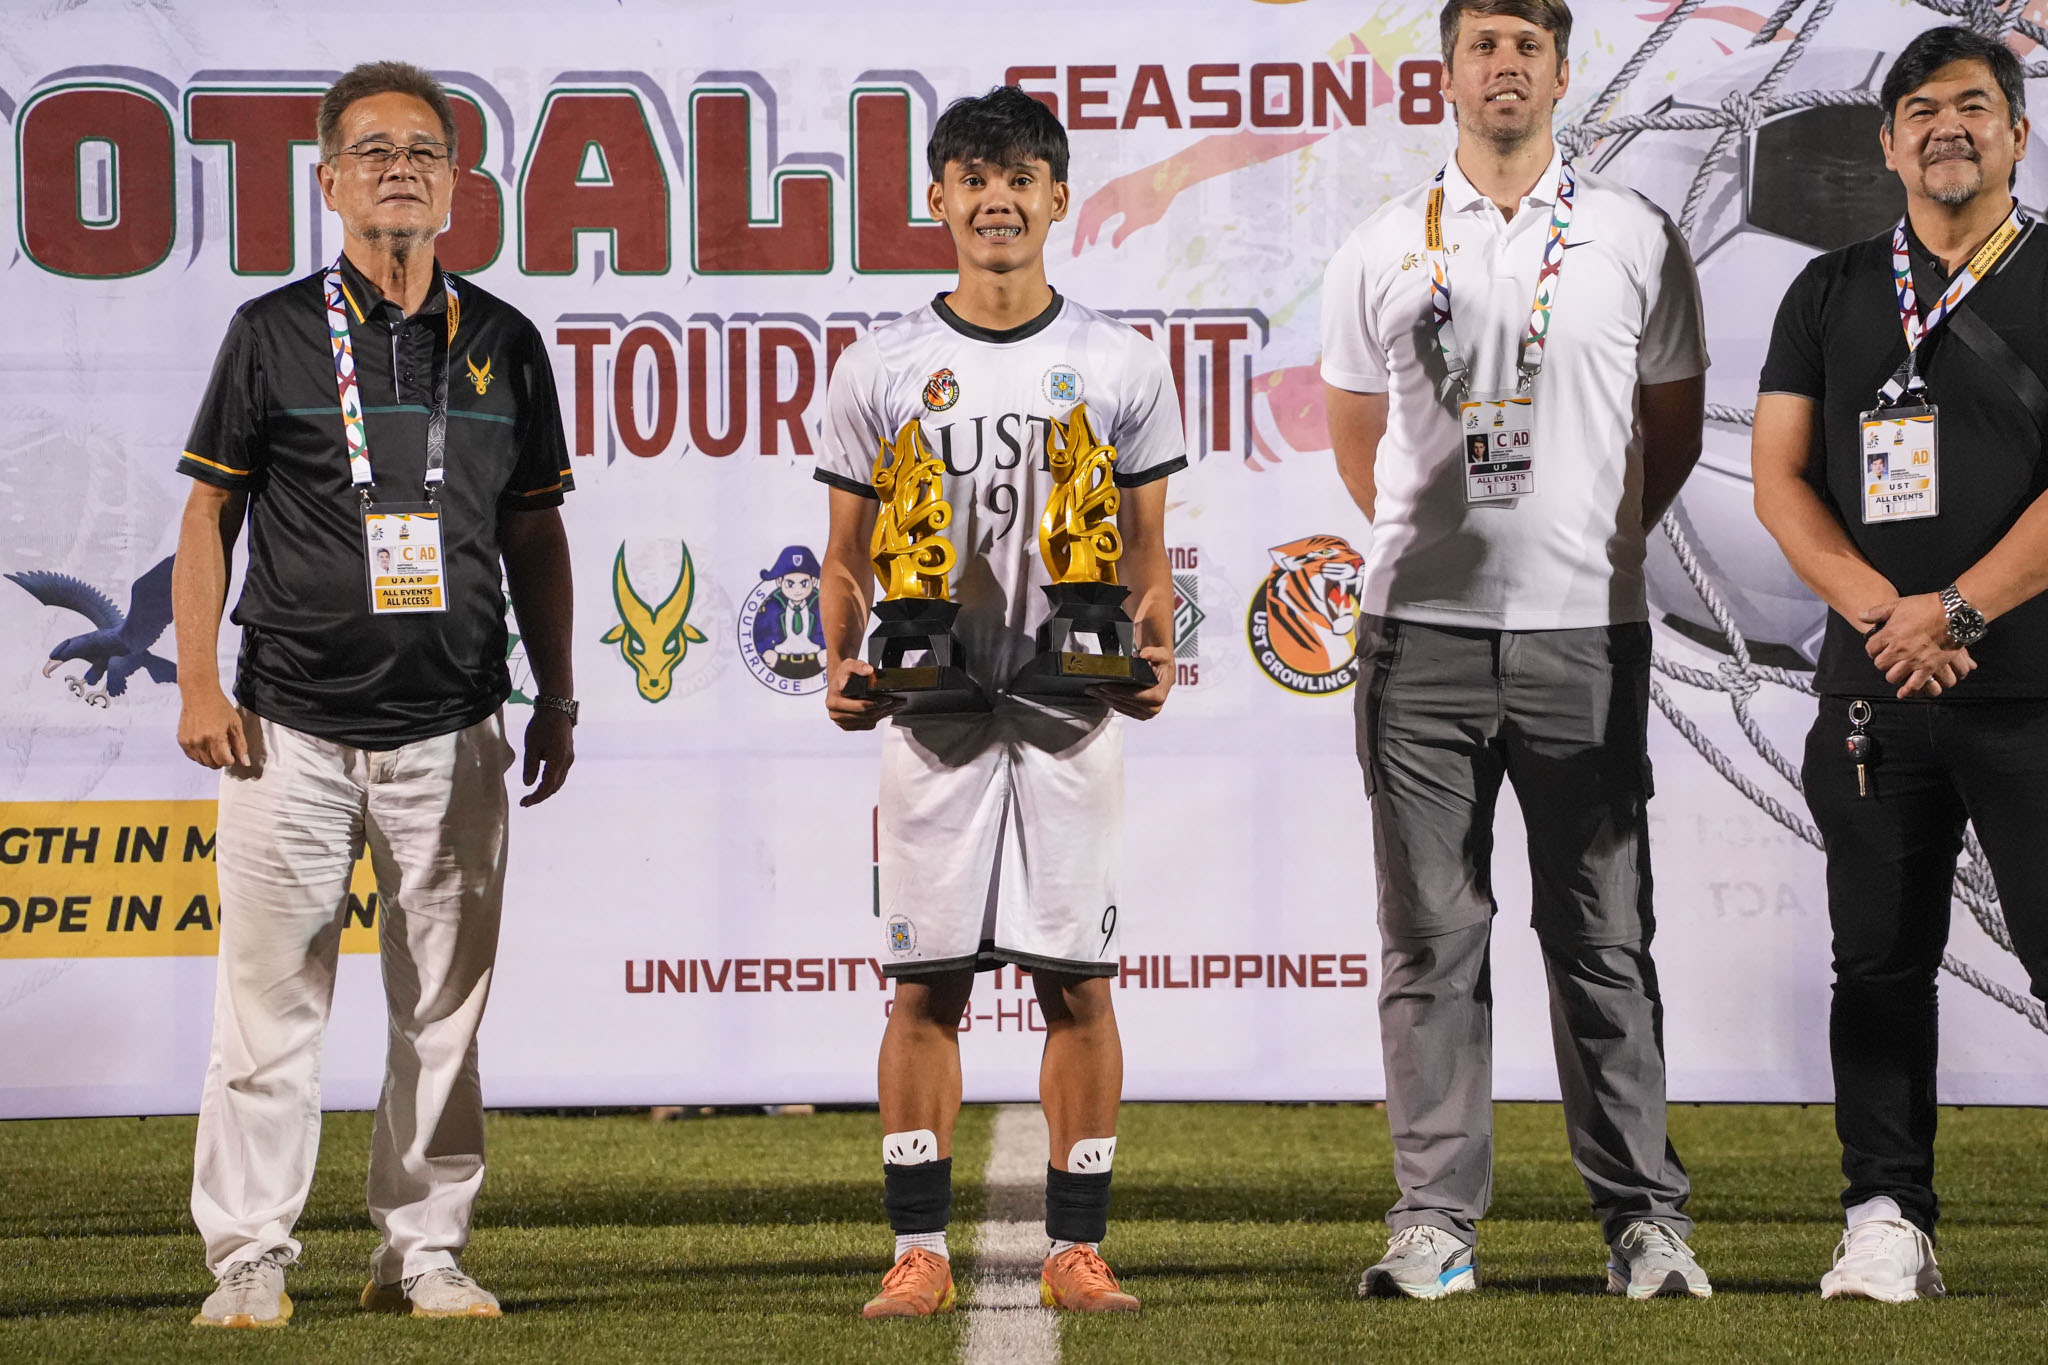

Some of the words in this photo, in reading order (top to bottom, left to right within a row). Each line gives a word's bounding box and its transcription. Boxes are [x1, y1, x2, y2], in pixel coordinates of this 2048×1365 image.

[1005, 61, 1366, 130] SEASON
[1991, 232, 2003, 246] HOPE
[1971, 250, 1987, 269] ACTION
[936, 412, 1069, 477] UST
[1497, 433, 1507, 447] C
[1513, 432, 1529, 446] AD
[1913, 450, 1929, 465] AD
[1487, 485, 1492, 494] 1
[1511, 483, 1517, 492] 3
[1494, 474, 1526, 483] EVENTS
[1892, 493, 1924, 502] EVENTS
[989, 483, 1019, 541] 9
[403, 547, 413, 561] C
[420, 546, 436, 561] AD
[387, 598, 400, 606] ALL
[402, 597, 430, 606] ACCESS
[742, 589, 800, 691] SOUTHRIDGE
[1253, 611, 1268, 647] UST
[1261, 651, 1351, 690] GROWLING
[114, 826, 169, 863] IN
[106, 895, 162, 932] IN
[1099, 905, 1117, 958] 9
[625, 958, 887, 993] UNIVERSITY
[1119, 954, 1368, 989] HILIPPINES
